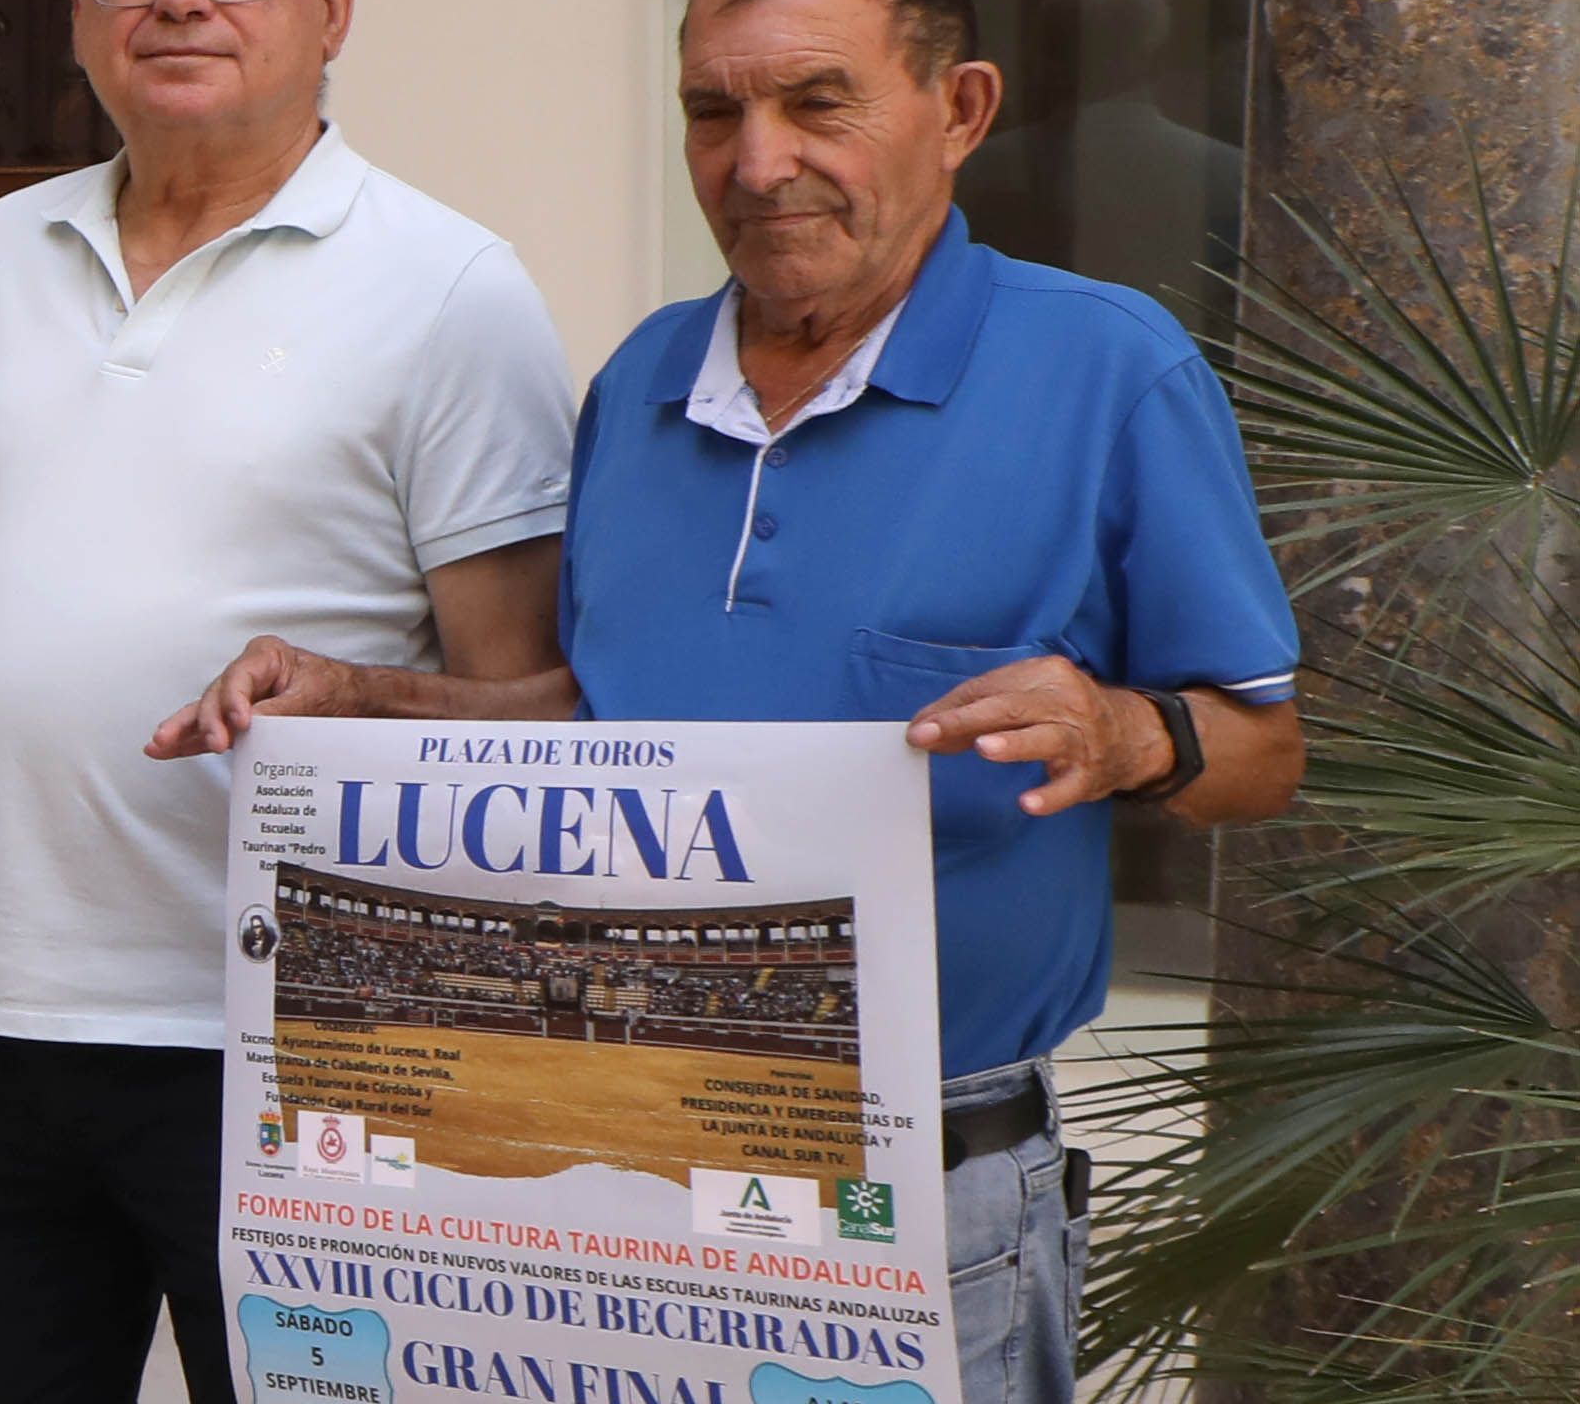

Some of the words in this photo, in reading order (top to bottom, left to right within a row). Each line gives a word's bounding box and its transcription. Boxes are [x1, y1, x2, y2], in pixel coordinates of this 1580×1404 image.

[419, 738, 513, 764] PLAZA
[521, 740, 561, 765] DE
[571, 740, 674, 767] TOROS
[333, 781, 755, 883] LUCENA
